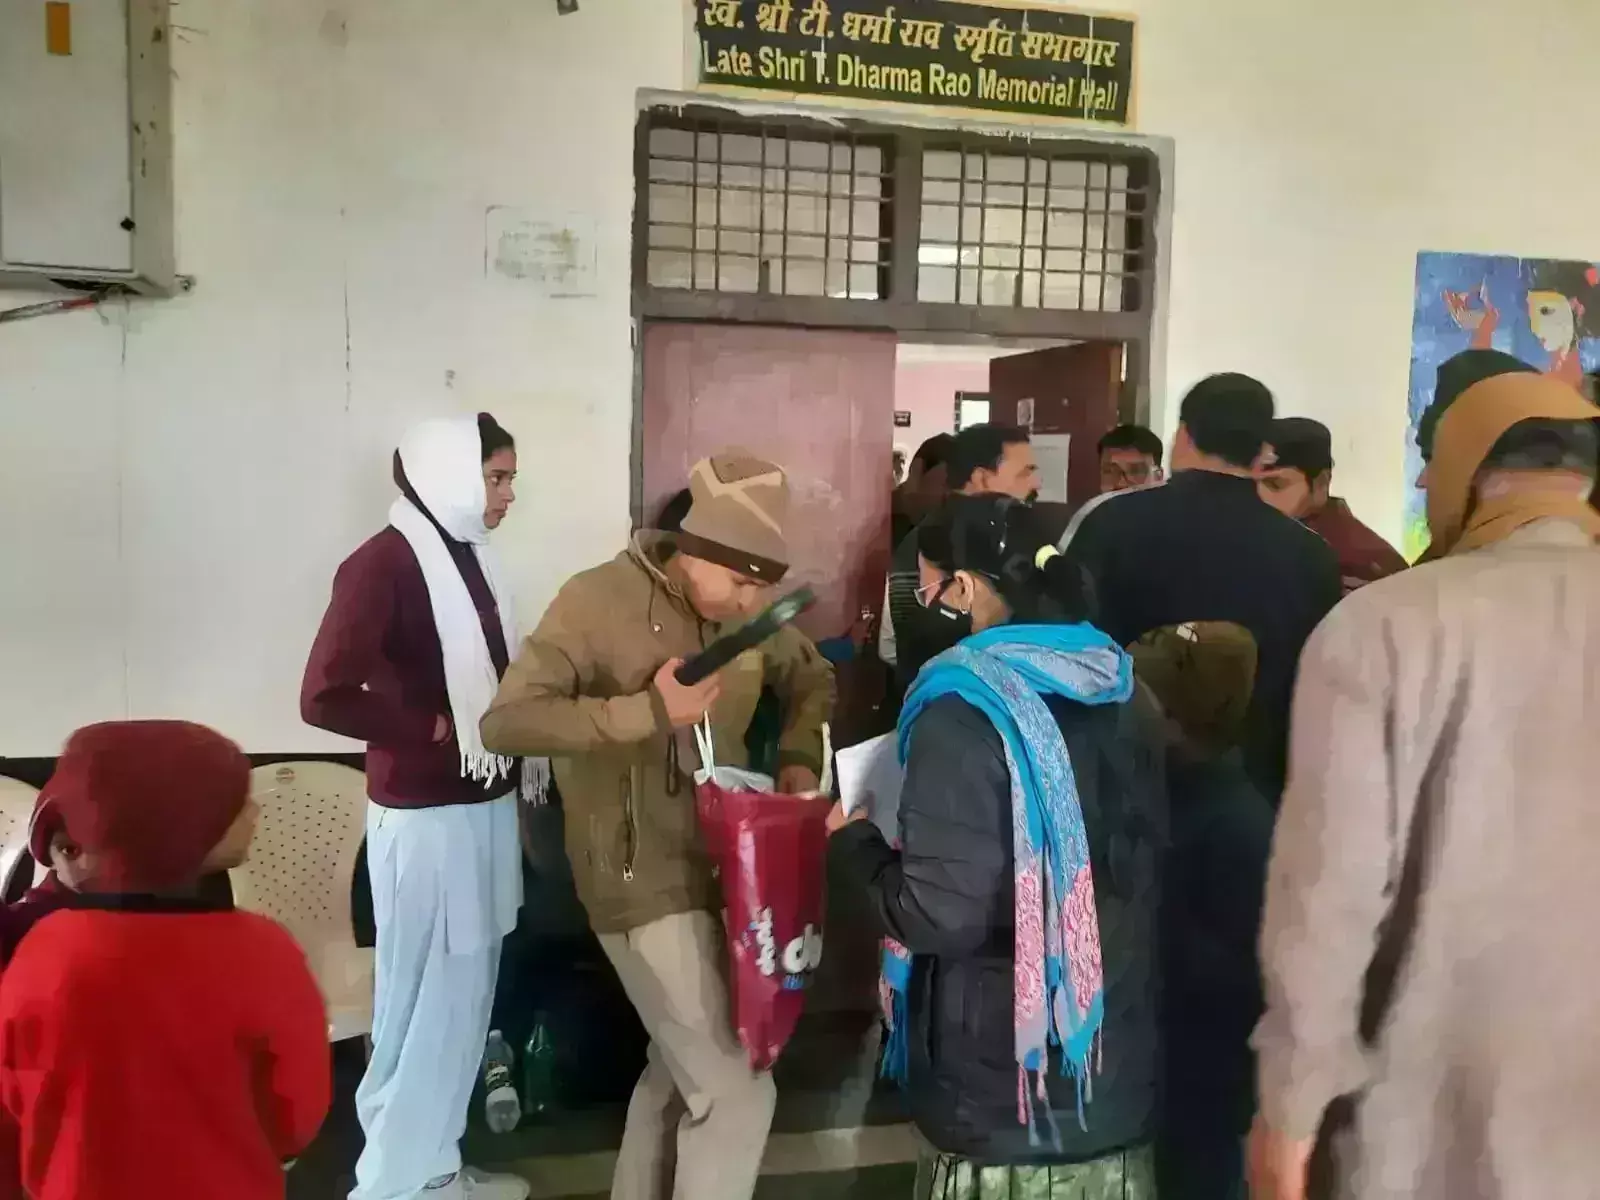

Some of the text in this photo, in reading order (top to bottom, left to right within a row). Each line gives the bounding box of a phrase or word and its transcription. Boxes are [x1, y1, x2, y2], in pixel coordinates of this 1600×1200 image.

[755, 0, 794, 33] श्री
[842, 6, 896, 44] धर्मा
[900, 18, 944, 50] राव
[953, 18, 1016, 63] स्मृति
[1020, 31, 1120, 67] सभागार
[703, 40, 1118, 111] Late Shri T. Dharma Rao Memorial Hall
